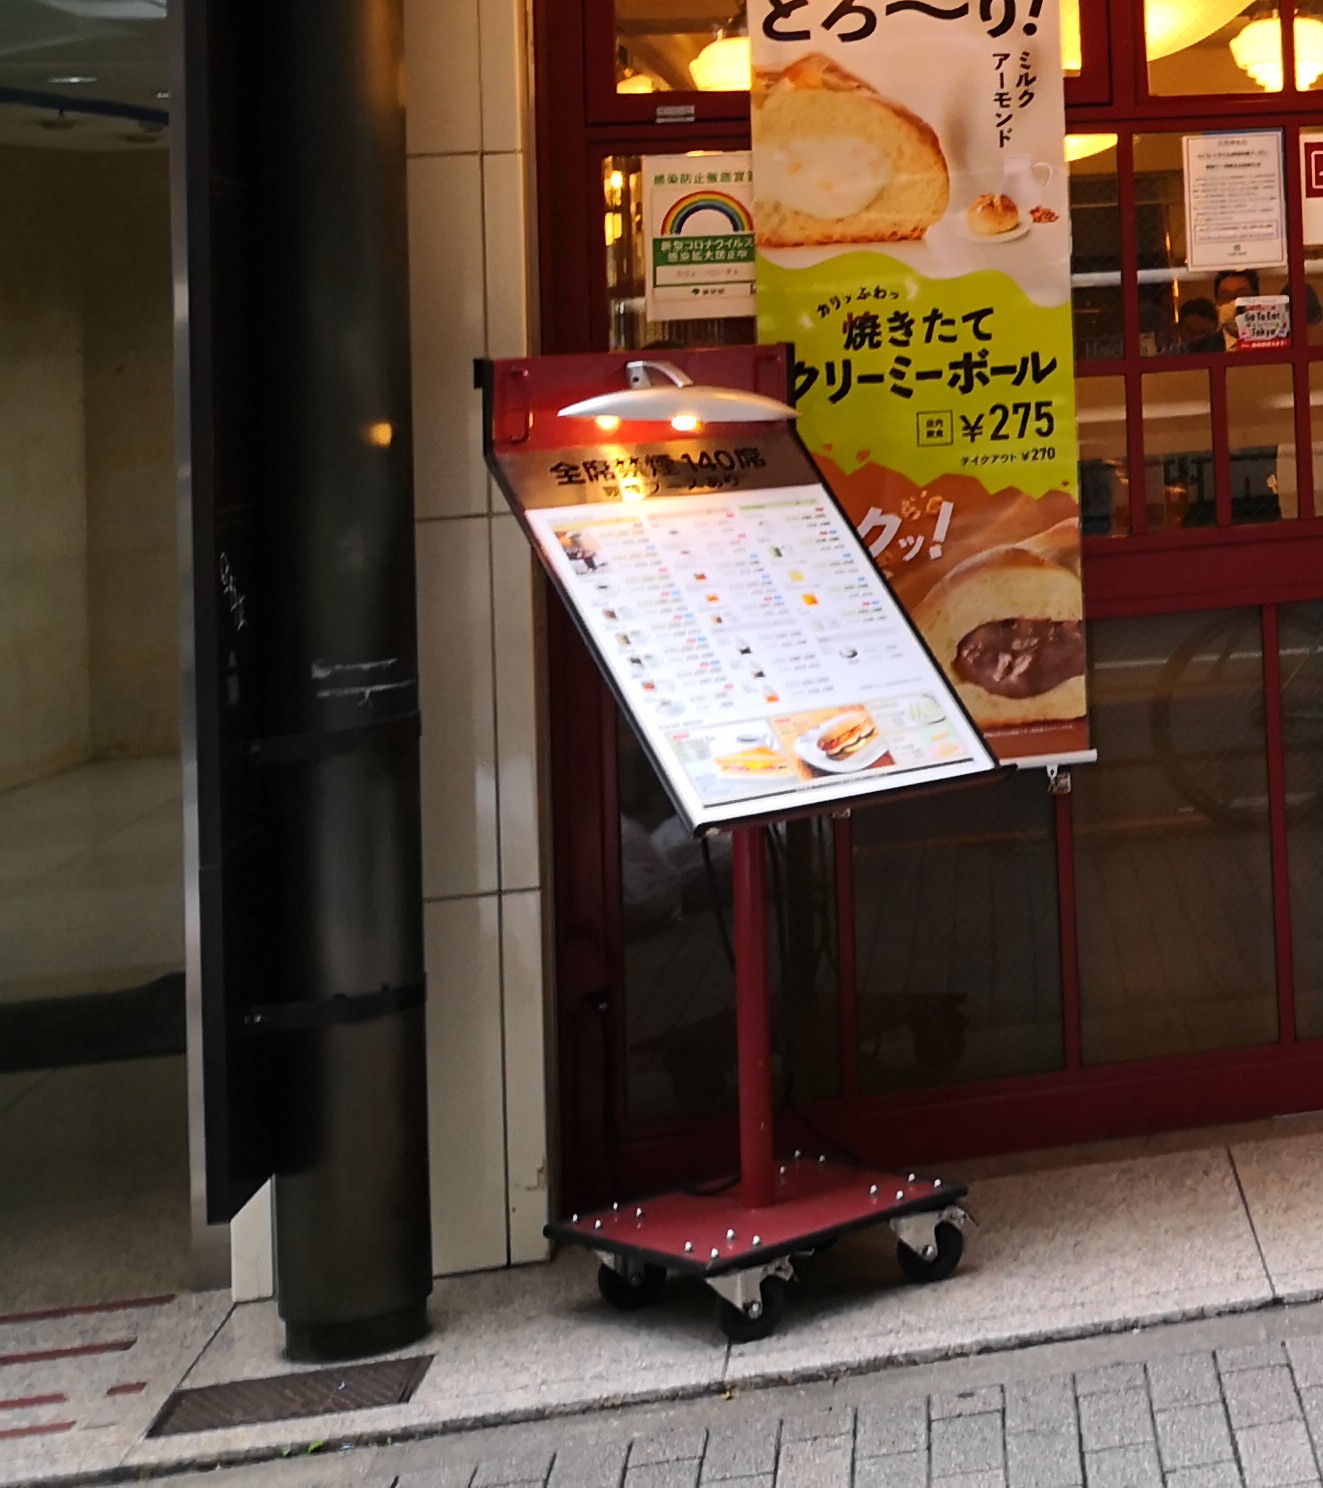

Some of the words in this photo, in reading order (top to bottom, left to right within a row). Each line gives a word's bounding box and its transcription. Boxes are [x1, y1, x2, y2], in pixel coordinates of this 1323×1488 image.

[992, 52, 1013, 148] アーモンド
[1016, 51, 1036, 108] ミルク
[661, 238, 754, 252] 新型コロナウイルス
[842, 307, 994, 351] 焼きたて
[794, 348, 1057, 404] クリーミーボール
[960, 401, 1054, 443] ¥275
[962, 454, 1017, 466] テイクアウト
[1022, 447, 1056, 462] ¥270
